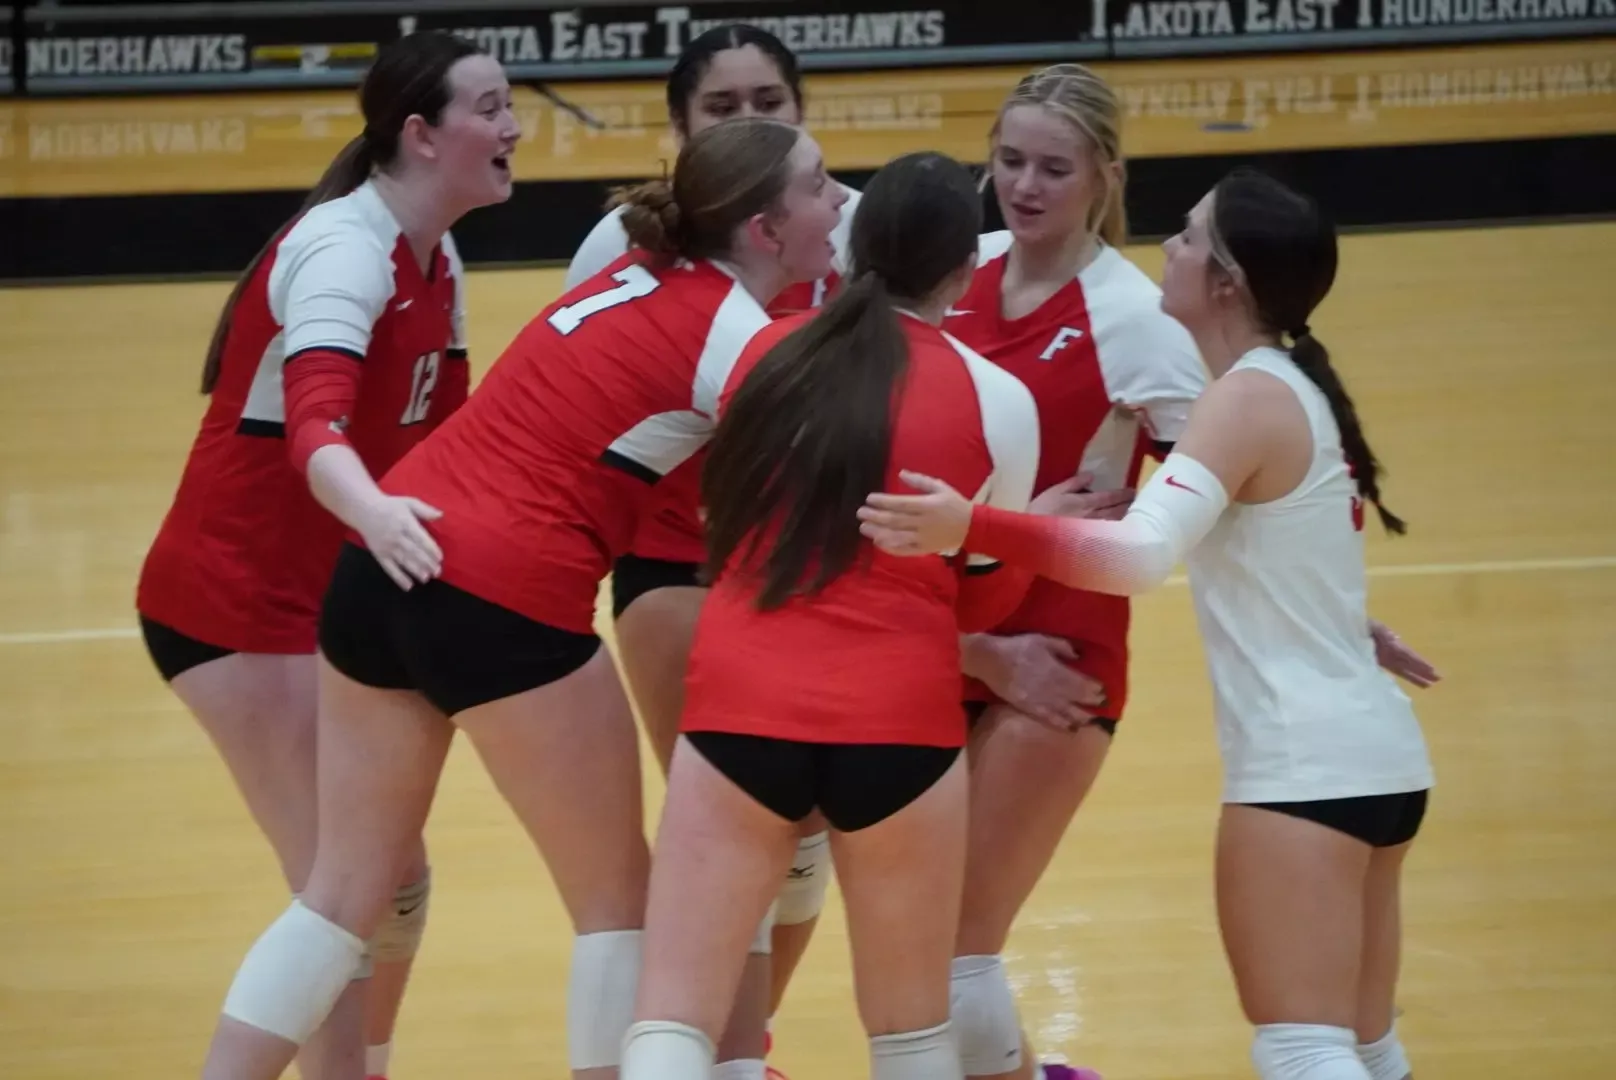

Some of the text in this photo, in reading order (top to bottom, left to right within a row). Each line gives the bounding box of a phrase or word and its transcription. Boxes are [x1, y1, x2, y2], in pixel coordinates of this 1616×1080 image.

[550, 11, 648, 60] EAST
[1091, 0, 1235, 38] LAKOTA
[1244, 0, 1339, 32] EAST
[546, 263, 662, 337] 7
[1038, 326, 1084, 361] F
[399, 350, 440, 426] 12
